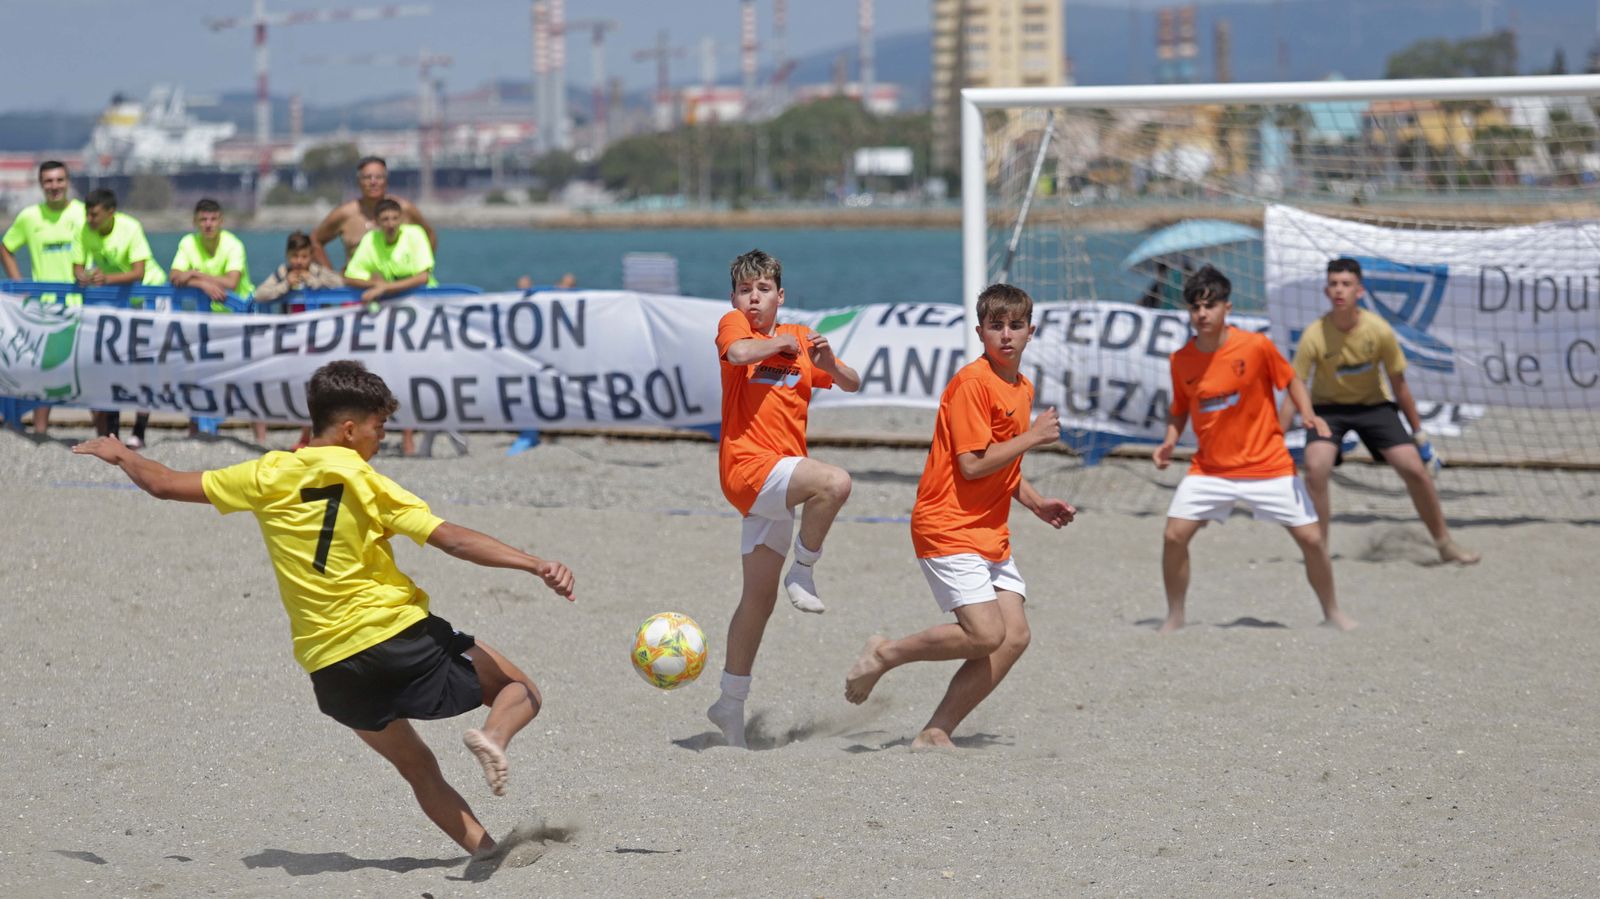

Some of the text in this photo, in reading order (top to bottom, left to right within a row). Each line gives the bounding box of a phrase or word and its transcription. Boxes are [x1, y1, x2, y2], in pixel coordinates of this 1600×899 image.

[93, 315, 224, 364] REAL
[877, 304, 1188, 358] RE FEDE
[1483, 340, 1543, 387] de
[111, 381, 397, 422] ANDALU
[410, 375, 485, 424] DE
[301, 483, 344, 575] 7
